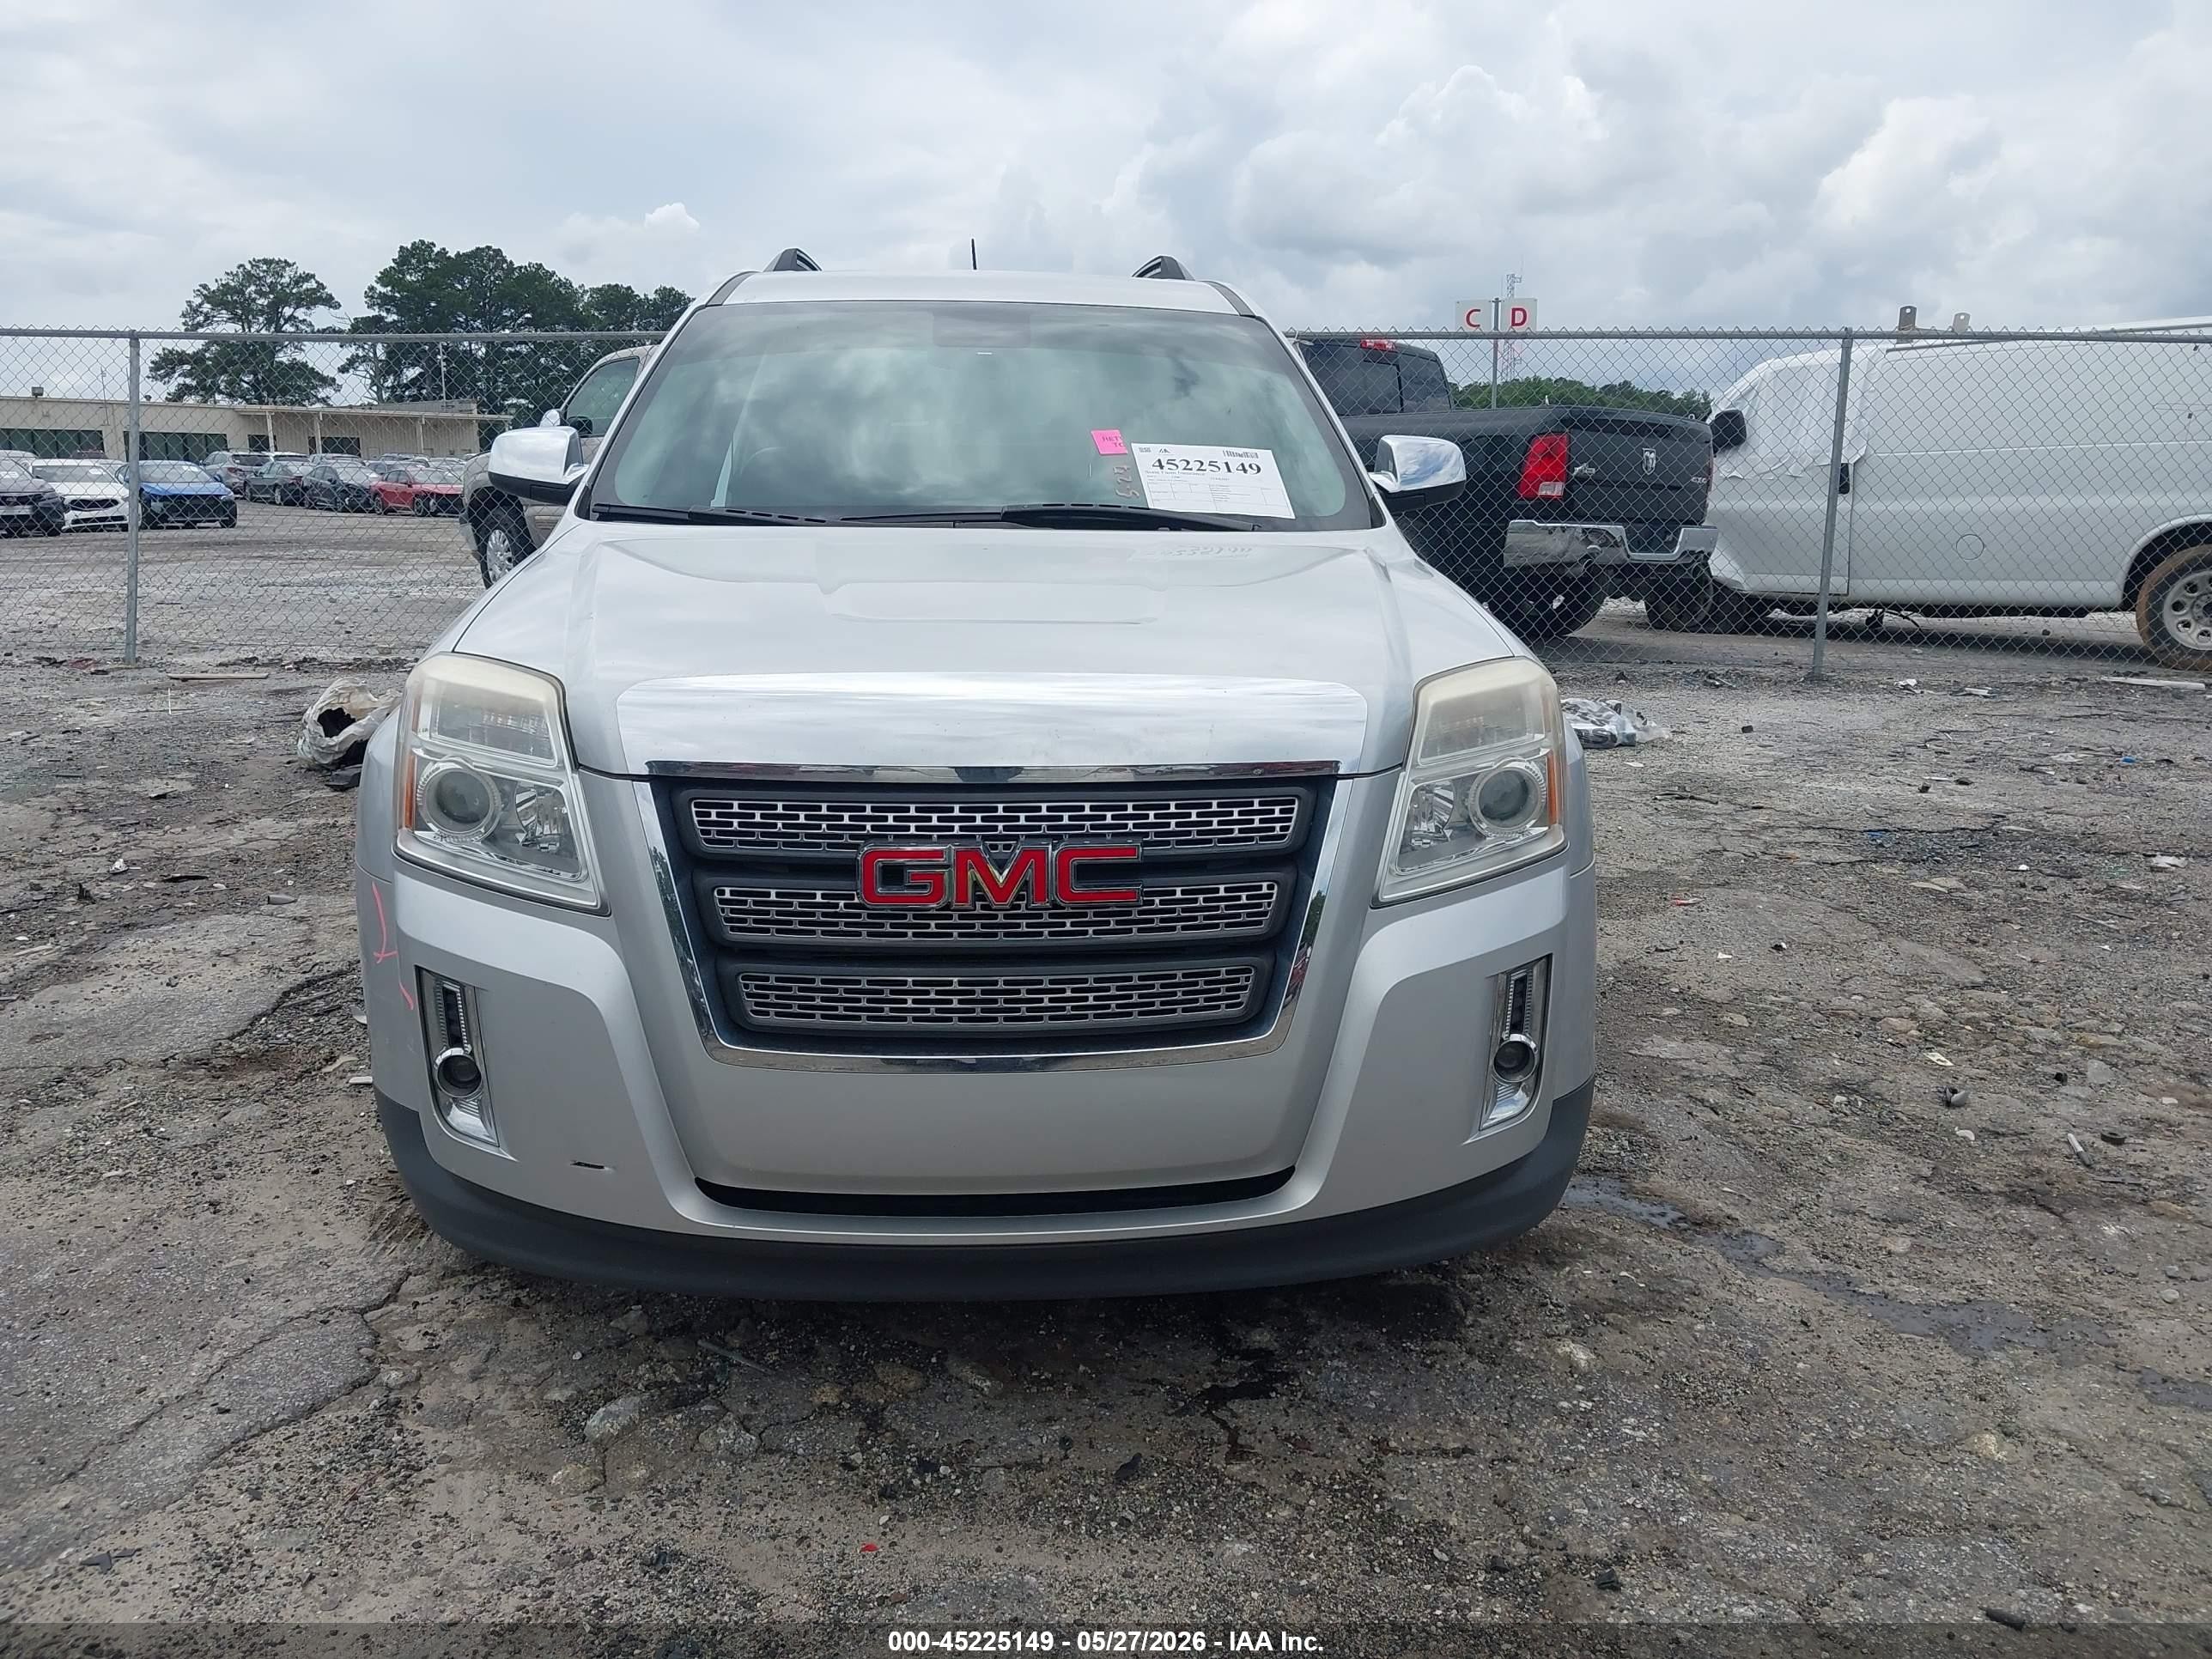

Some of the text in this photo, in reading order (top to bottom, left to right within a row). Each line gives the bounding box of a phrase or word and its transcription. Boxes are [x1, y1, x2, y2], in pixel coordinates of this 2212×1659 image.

[1466, 308, 1481, 328] C
[1510, 307, 1528, 327] D
[1152, 458, 1261, 475] 45225149
[859, 842, 1142, 908] GMC
